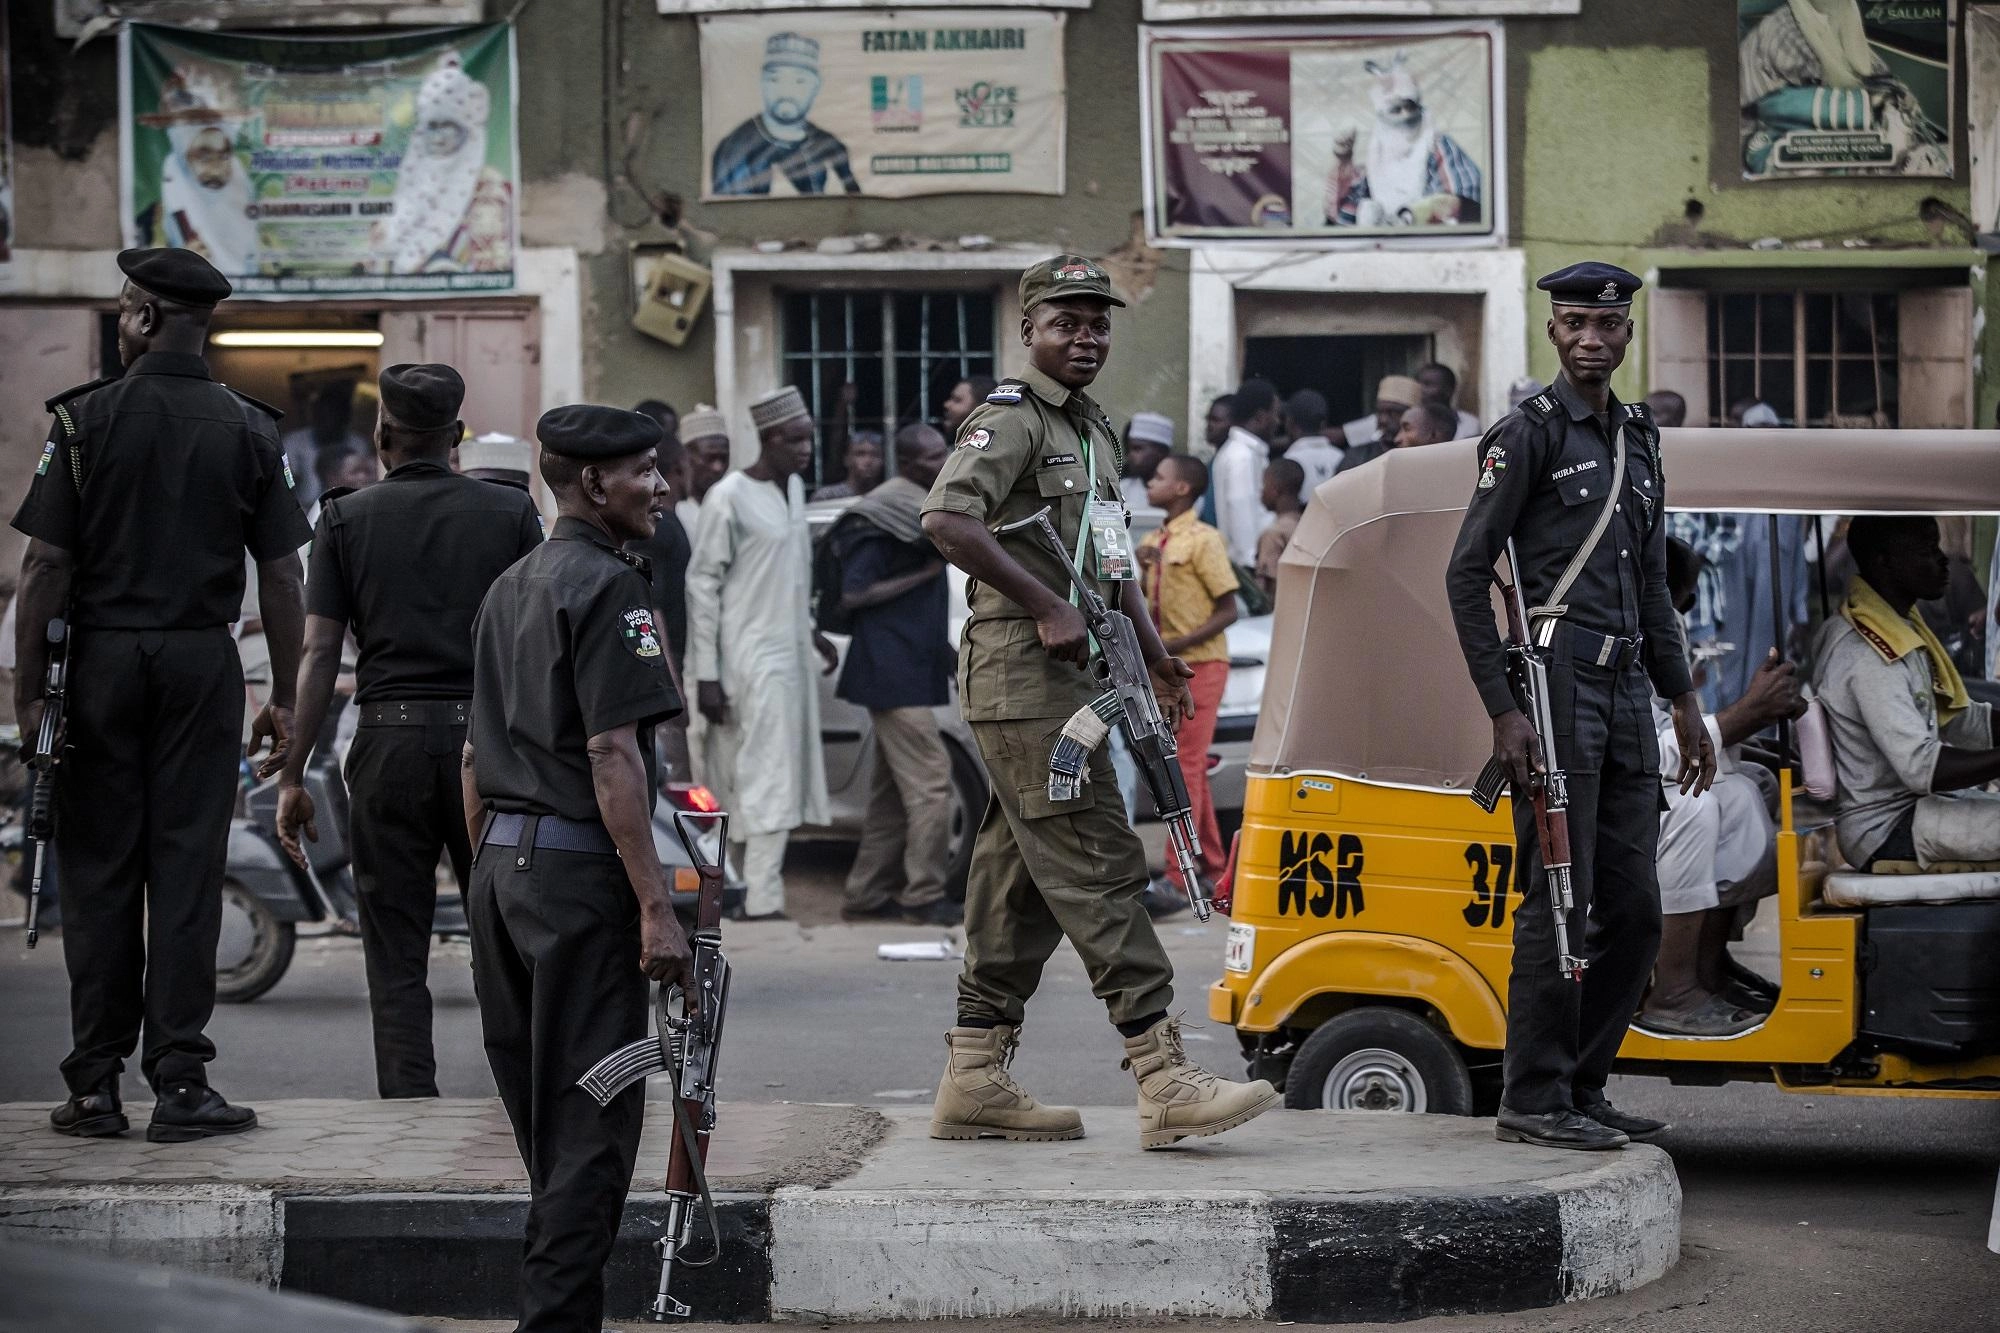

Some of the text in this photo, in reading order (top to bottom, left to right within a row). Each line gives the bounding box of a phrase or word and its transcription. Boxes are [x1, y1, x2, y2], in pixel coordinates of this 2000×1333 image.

[1888, 7, 1942, 20] SALLAH
[862, 28, 1025, 52] FATAN AKHAIRI
[955, 82, 1017, 103] HOPE
[960, 105, 1015, 125] 2019
[1552, 460, 1598, 480] NURA NASIR
[624, 609, 652, 623] NIGERIA
[1462, 843, 1522, 929] 37
